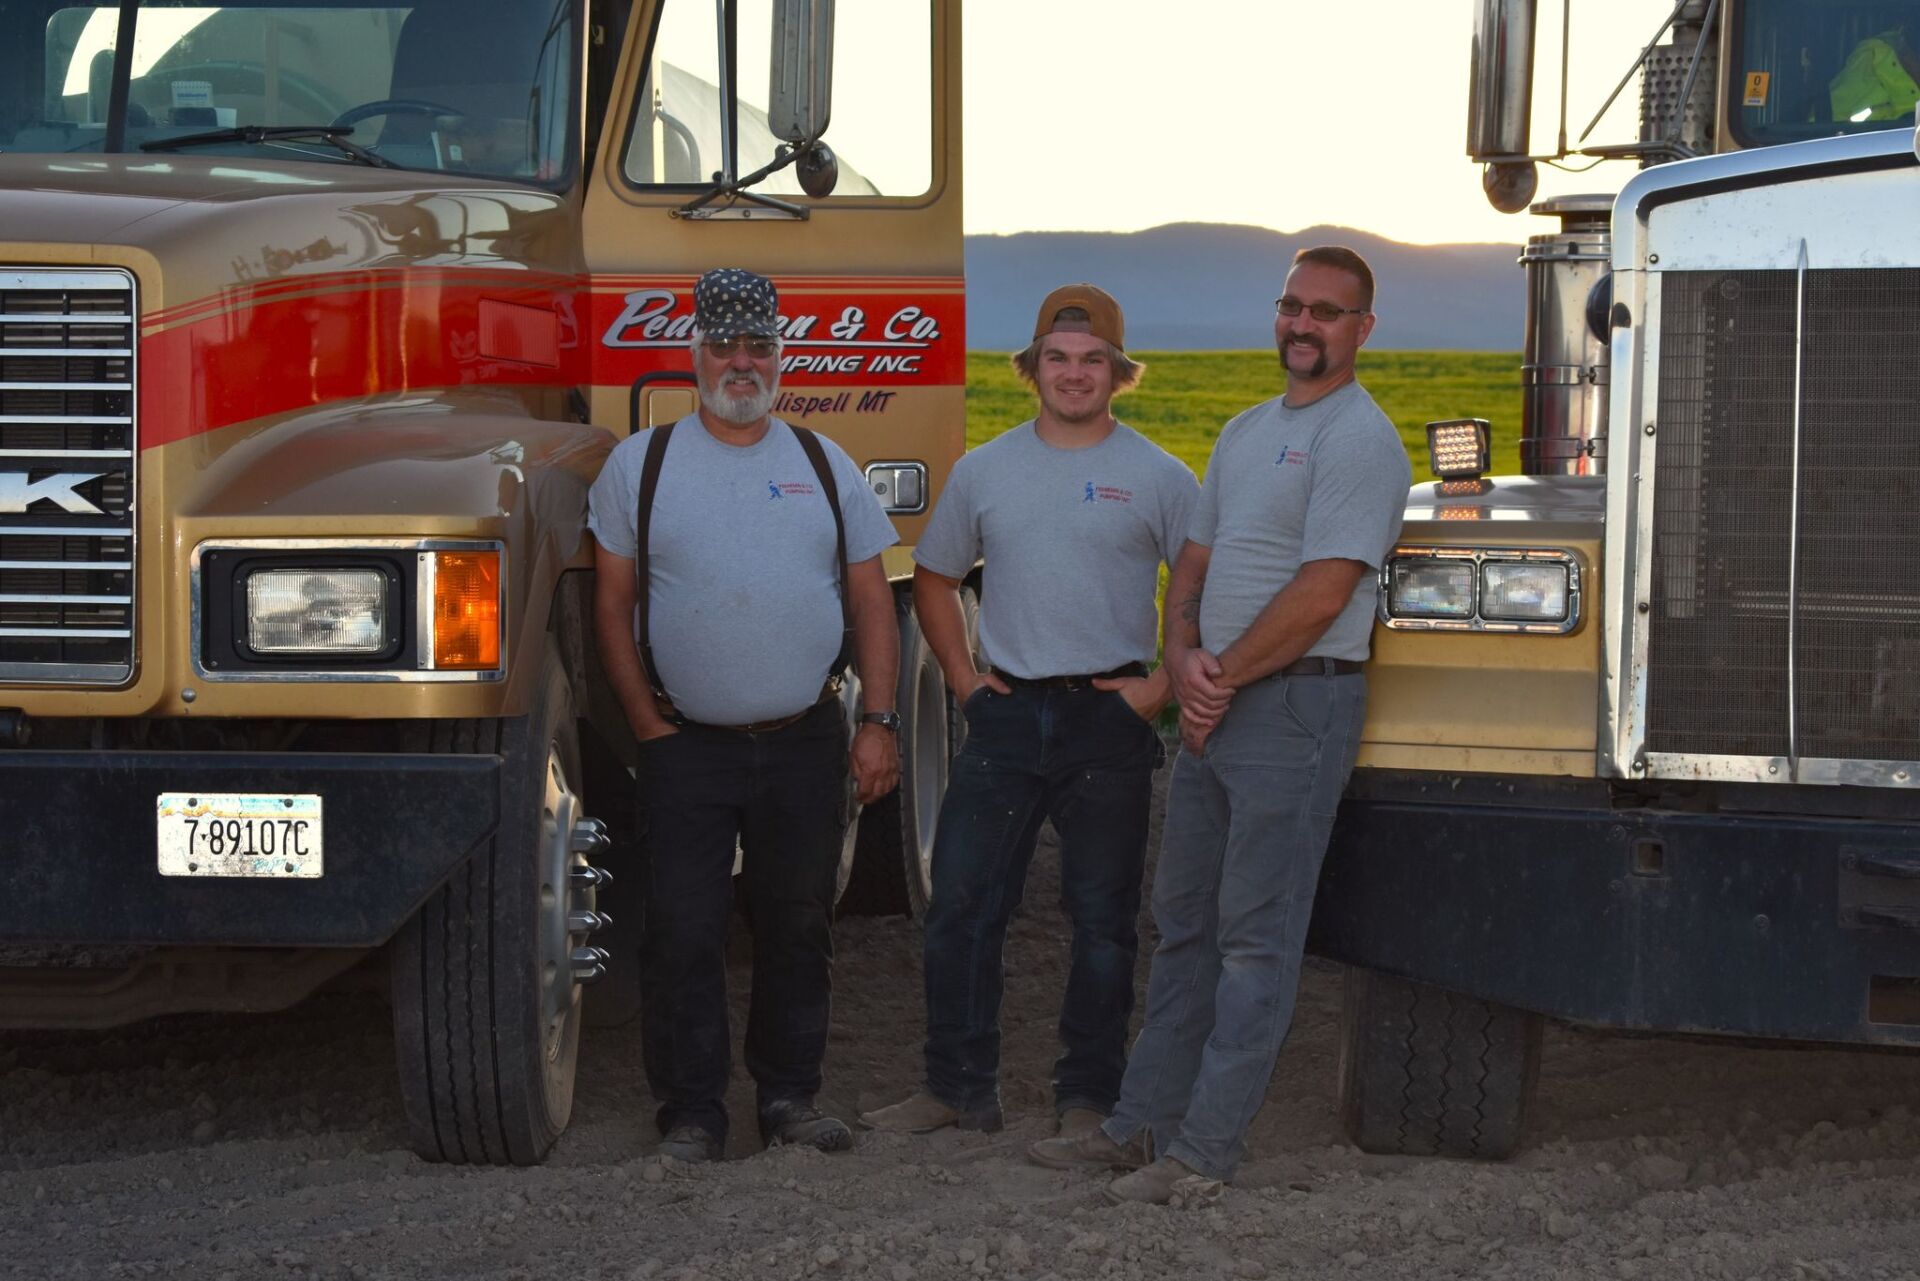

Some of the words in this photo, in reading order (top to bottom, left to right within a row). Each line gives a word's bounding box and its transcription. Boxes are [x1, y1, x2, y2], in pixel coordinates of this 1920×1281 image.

[830, 306, 865, 340] &
[884, 306, 940, 340] Co.
[867, 355, 922, 373] INC.
[768, 391, 852, 418] lispell
[856, 390, 897, 413] MT
